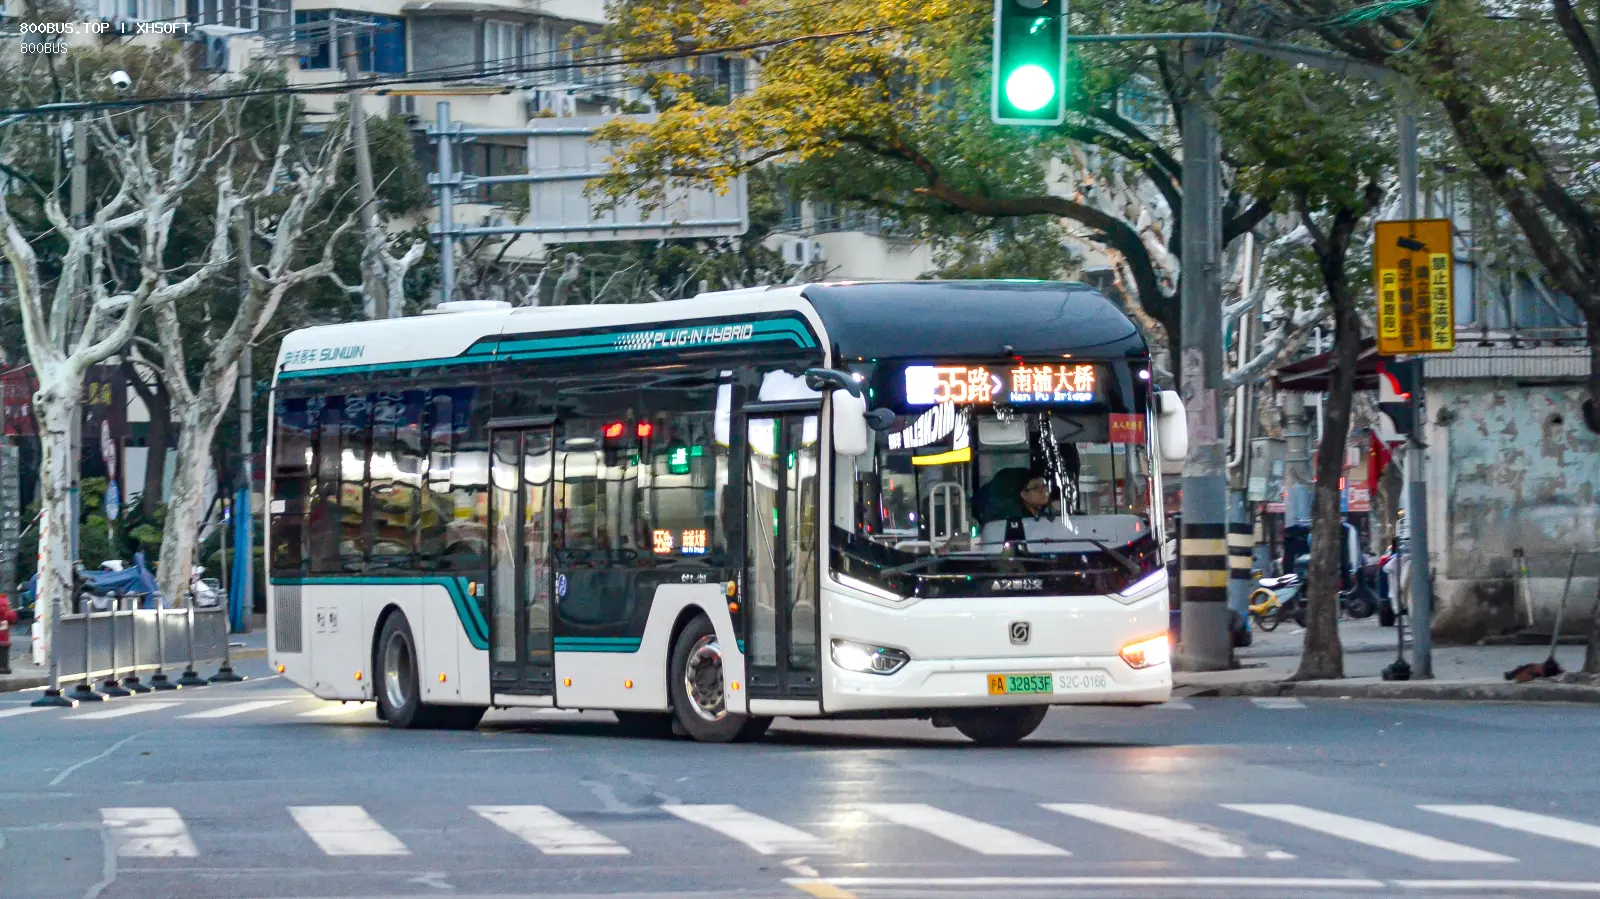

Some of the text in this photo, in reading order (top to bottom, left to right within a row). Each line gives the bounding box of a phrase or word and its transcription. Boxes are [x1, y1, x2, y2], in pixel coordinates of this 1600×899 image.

[1431, 257, 1449, 344] 禁止违法停车
[653, 324, 753, 347] PLUG-IN HYBRID
[319, 345, 366, 362] SUNWIN
[934, 366, 993, 402] 55路
[1010, 365, 1096, 392] 南浦大桥
[1009, 391, 1031, 402] Nan
[1034, 391, 1050, 402] Pu
[1009, 676, 1052, 691] 32853F
[1059, 676, 1107, 689] S2C-0166
